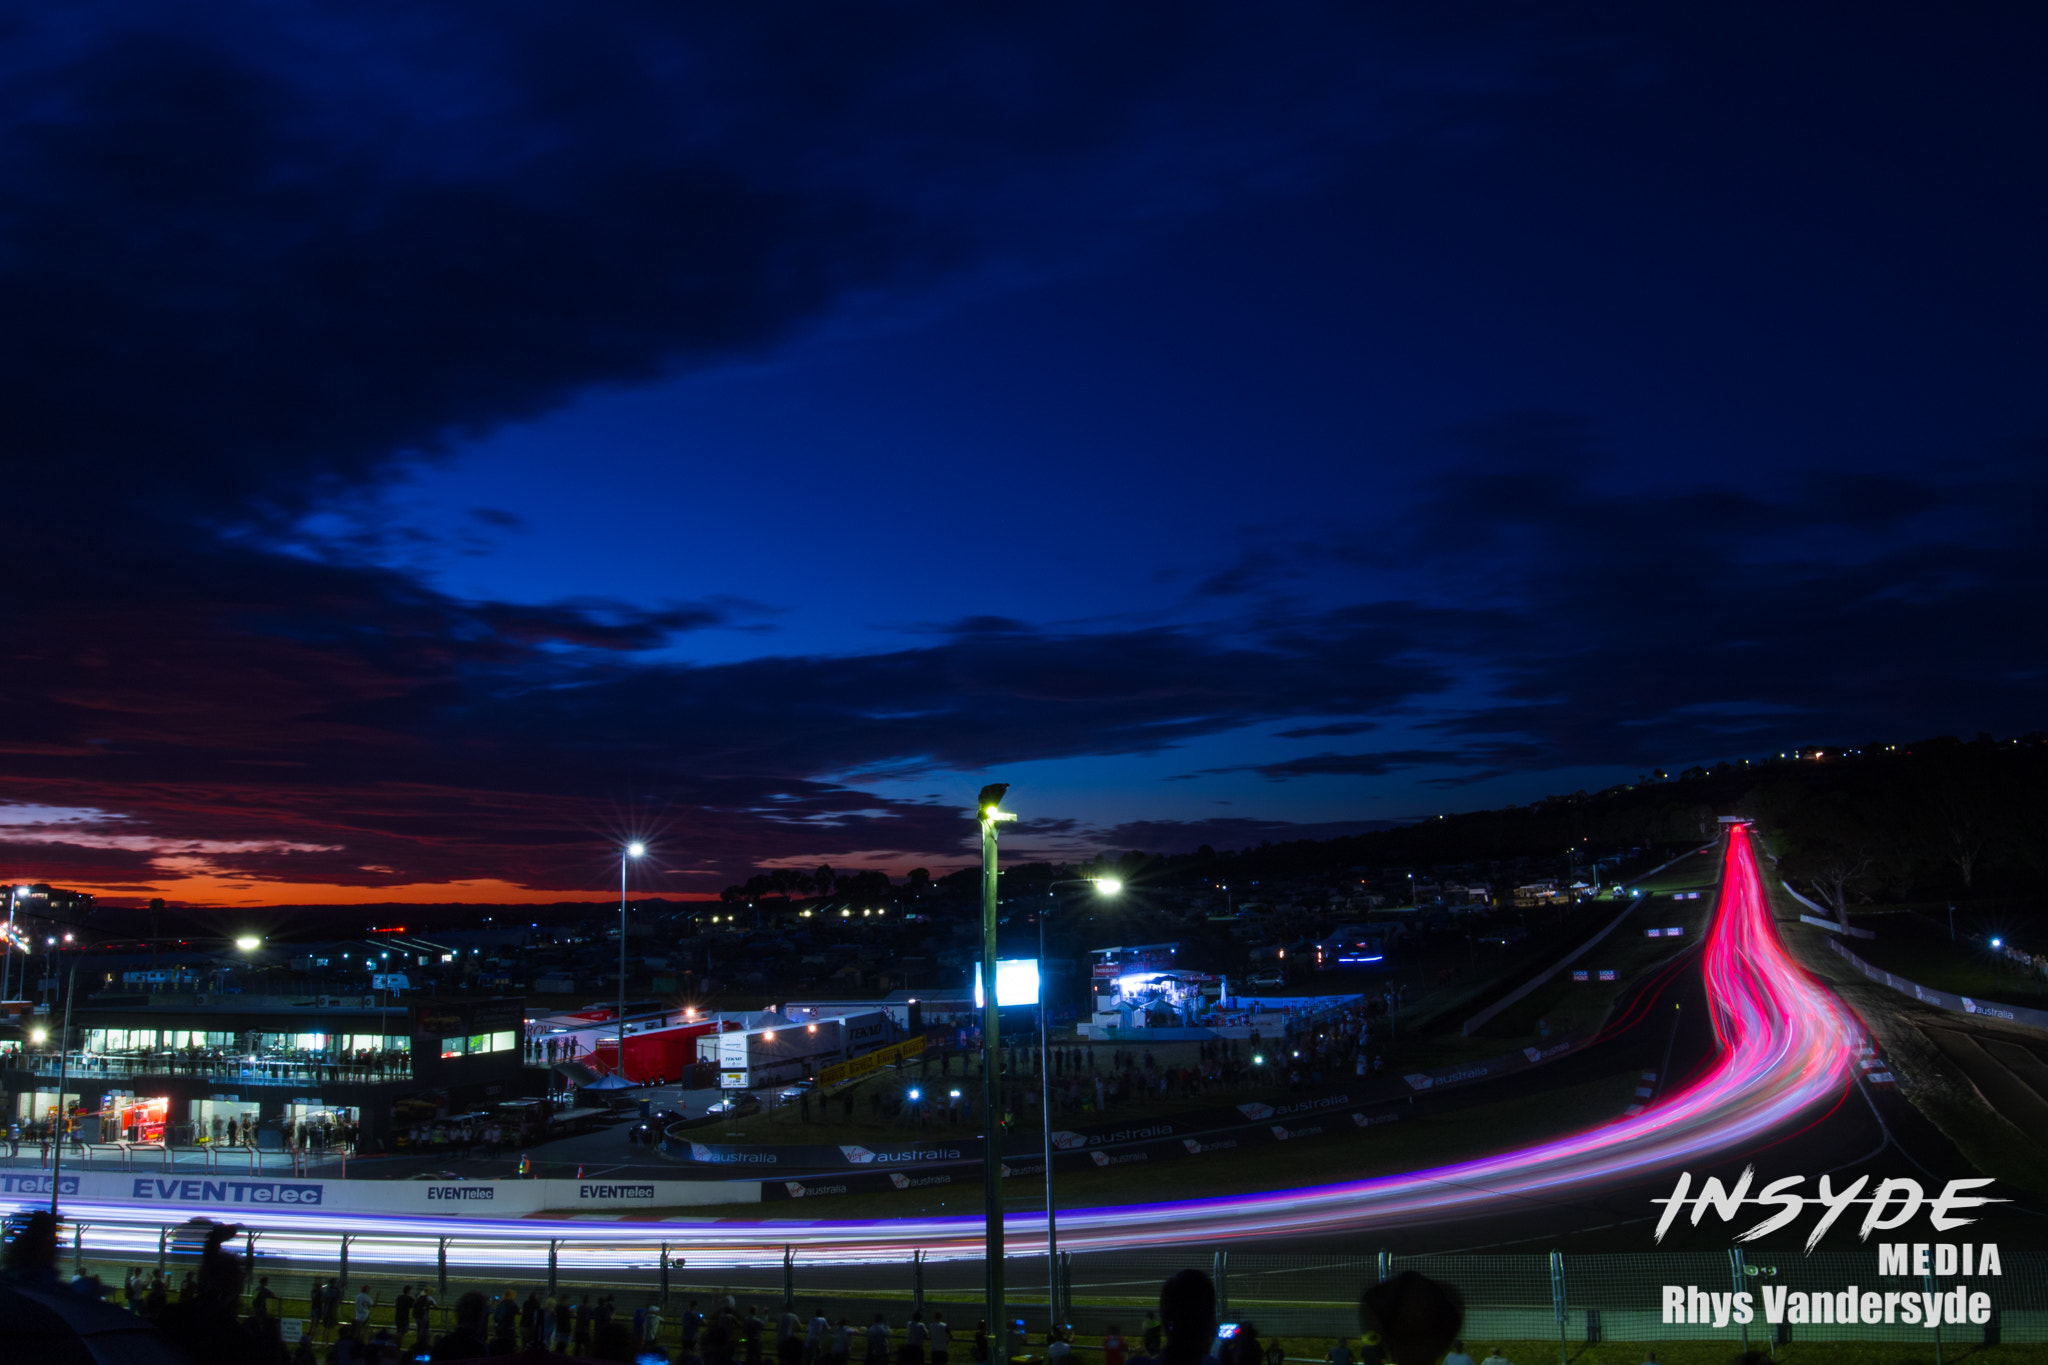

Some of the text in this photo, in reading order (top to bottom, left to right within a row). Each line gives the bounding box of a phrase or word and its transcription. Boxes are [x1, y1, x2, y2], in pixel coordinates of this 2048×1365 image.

[1976, 1005, 2014, 1020] australia
[1435, 1066, 1488, 1086] australia
[1276, 1094, 1348, 1115] australia
[1054, 1124, 1173, 1149] Virgin australia
[1201, 1139, 1237, 1151] australia
[711, 1152, 777, 1163] australia
[846, 1147, 960, 1162] Virgin australia
[1110, 1152, 1148, 1165] australia
[1011, 1164, 1047, 1176] australi
[910, 1175, 951, 1187] australia
[133, 1178, 322, 1205] EVENTelec
[428, 1187, 493, 1199] EVENTelec
[580, 1185, 654, 1198] EVENTelec
[806, 1184, 847, 1196] australia
